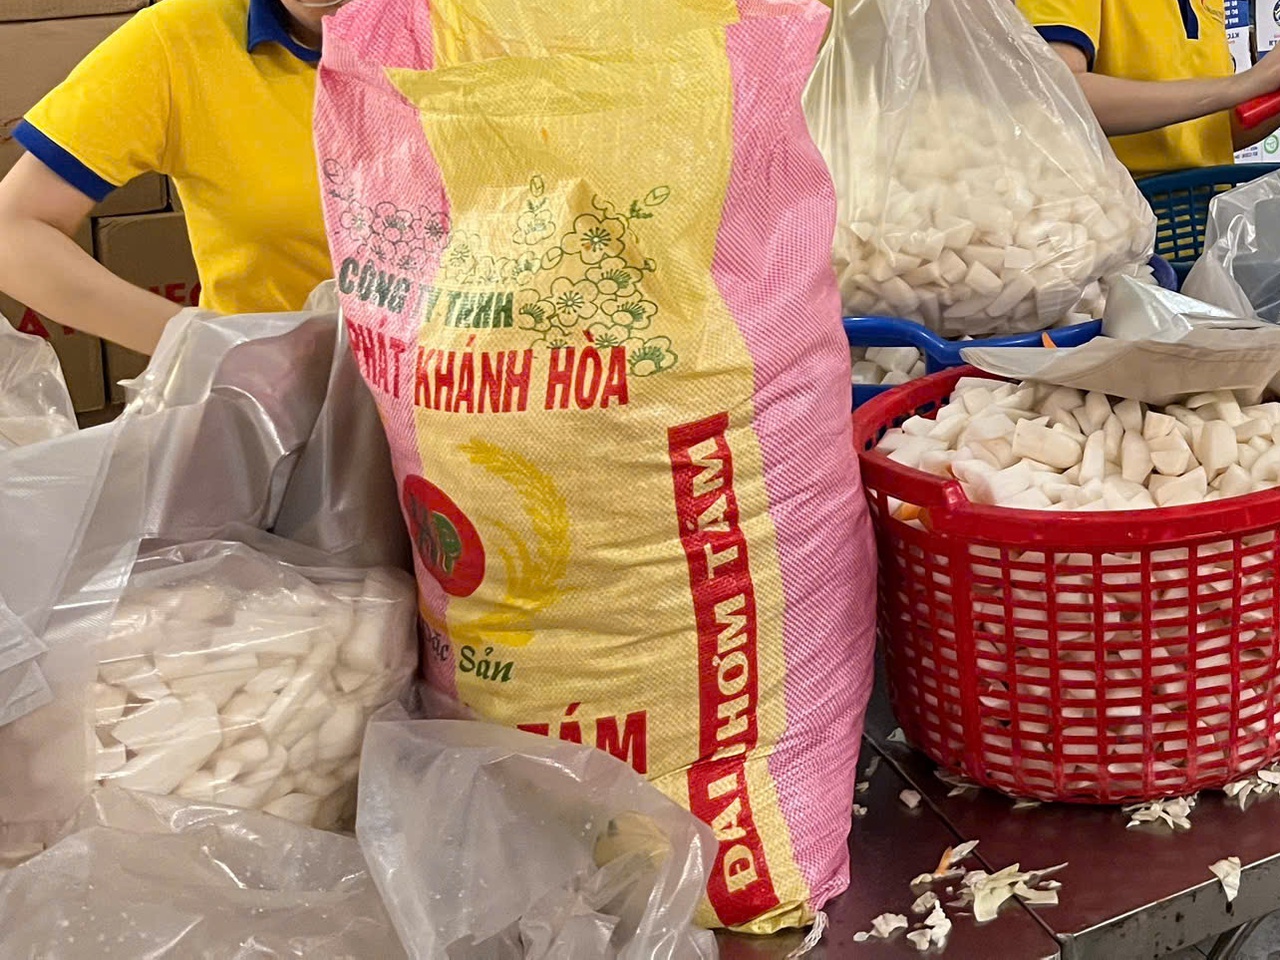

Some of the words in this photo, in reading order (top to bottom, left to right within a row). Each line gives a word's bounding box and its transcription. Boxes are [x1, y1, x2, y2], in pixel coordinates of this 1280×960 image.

[339, 257, 411, 313] CÔNG
[446, 290, 514, 329] TNHH
[414, 333, 533, 414] KHÁNH
[545, 328, 629, 411] HÒA
[459, 645, 514, 682] Sản
